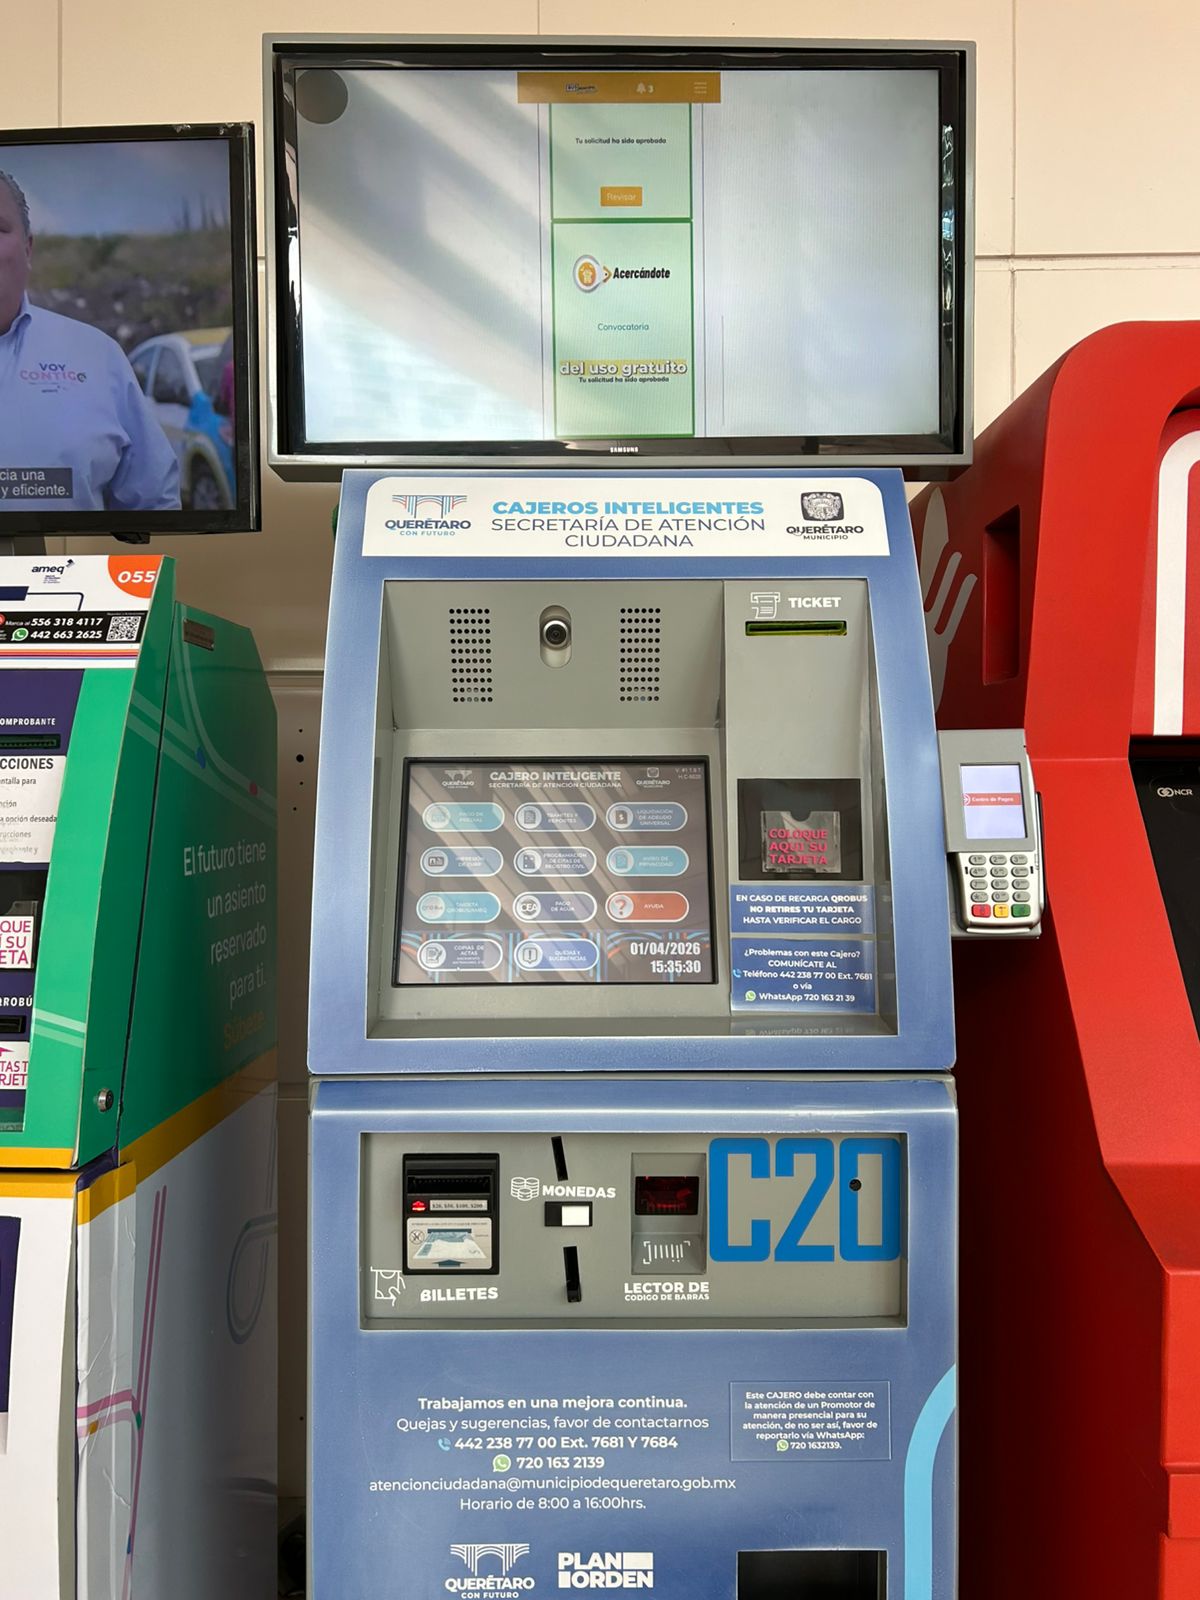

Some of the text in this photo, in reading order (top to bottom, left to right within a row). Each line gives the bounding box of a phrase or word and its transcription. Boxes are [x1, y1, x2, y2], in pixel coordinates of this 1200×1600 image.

[613, 267, 670, 279] Acercándote
[39, 363, 65, 371] VOY
[560, 361, 687, 377] del uso gratuito
[22, 471, 45, 480] una
[1, 484, 69, 499] y eficiente.
[493, 502, 764, 514] CAJEROS INTELIGENTES
[385, 517, 471, 530] QUERÉTARO
[492, 516, 765, 531] SECRETARÍA DE ATENCIÓN
[786, 524, 864, 536] QUERÉTARO
[565, 535, 693, 547] CIUDADANA
[32, 566, 64, 574] ameq
[117, 571, 156, 583] 055
[788, 597, 841, 608] TICKET
[31, 618, 51, 626] 556
[53, 618, 74, 626] 318
[53, 631, 73, 639] 663
[490, 772, 621, 781] CAJERO INTELIGENTE
[769, 828, 828, 841] COLOQUE
[184, 840, 266, 876] El futuro tiene
[769, 854, 828, 865] TARJETA
[207, 883, 266, 918] un asiento
[831, 895, 868, 903] QROBUS
[6, 936, 26, 948] SU
[211, 922, 267, 965] reservado
[631, 942, 700, 955] 01/04/2026
[744, 948, 792, 956] ¿Problemas
[830, 950, 860, 959] Cajero?
[651, 960, 701, 973] 15:35:30
[768, 959, 824, 968] COMUNÍCATE
[743, 970, 778, 978] Teléfono
[759, 993, 802, 1002] WhatsApp
[542, 1185, 616, 1198] MONEDAS
[709, 1138, 900, 1262] C20
[625, 1282, 709, 1293] LECTOR DE
[420, 1287, 498, 1302] BILLETES
[418, 1395, 687, 1412] Trabajamos en una mejora continua.
[397, 1416, 709, 1432] Quejas y sugerencias, favor de contactarnos
[455, 1436, 678, 1449] 442 238 77 00 Ext. 7681 Y 7684
[756, 1432, 800, 1441] reportarlo
[816, 1432, 864, 1440] WhatsApp:
[808, 1441, 842, 1449] 1632139.
[517, 1457, 604, 1469] 720 163 2139
[370, 1476, 736, 1492] atencionciudadana@municipiodequeretaro.gob.mx
[461, 1497, 646, 1510] Horario de 8:00 a 16:00hrs.
[558, 1552, 621, 1570] PLAN
[445, 1575, 535, 1591] QUERÉTARO
[572, 1571, 653, 1588] ORDEN
[461, 1591, 519, 1599] CON FUTURO
